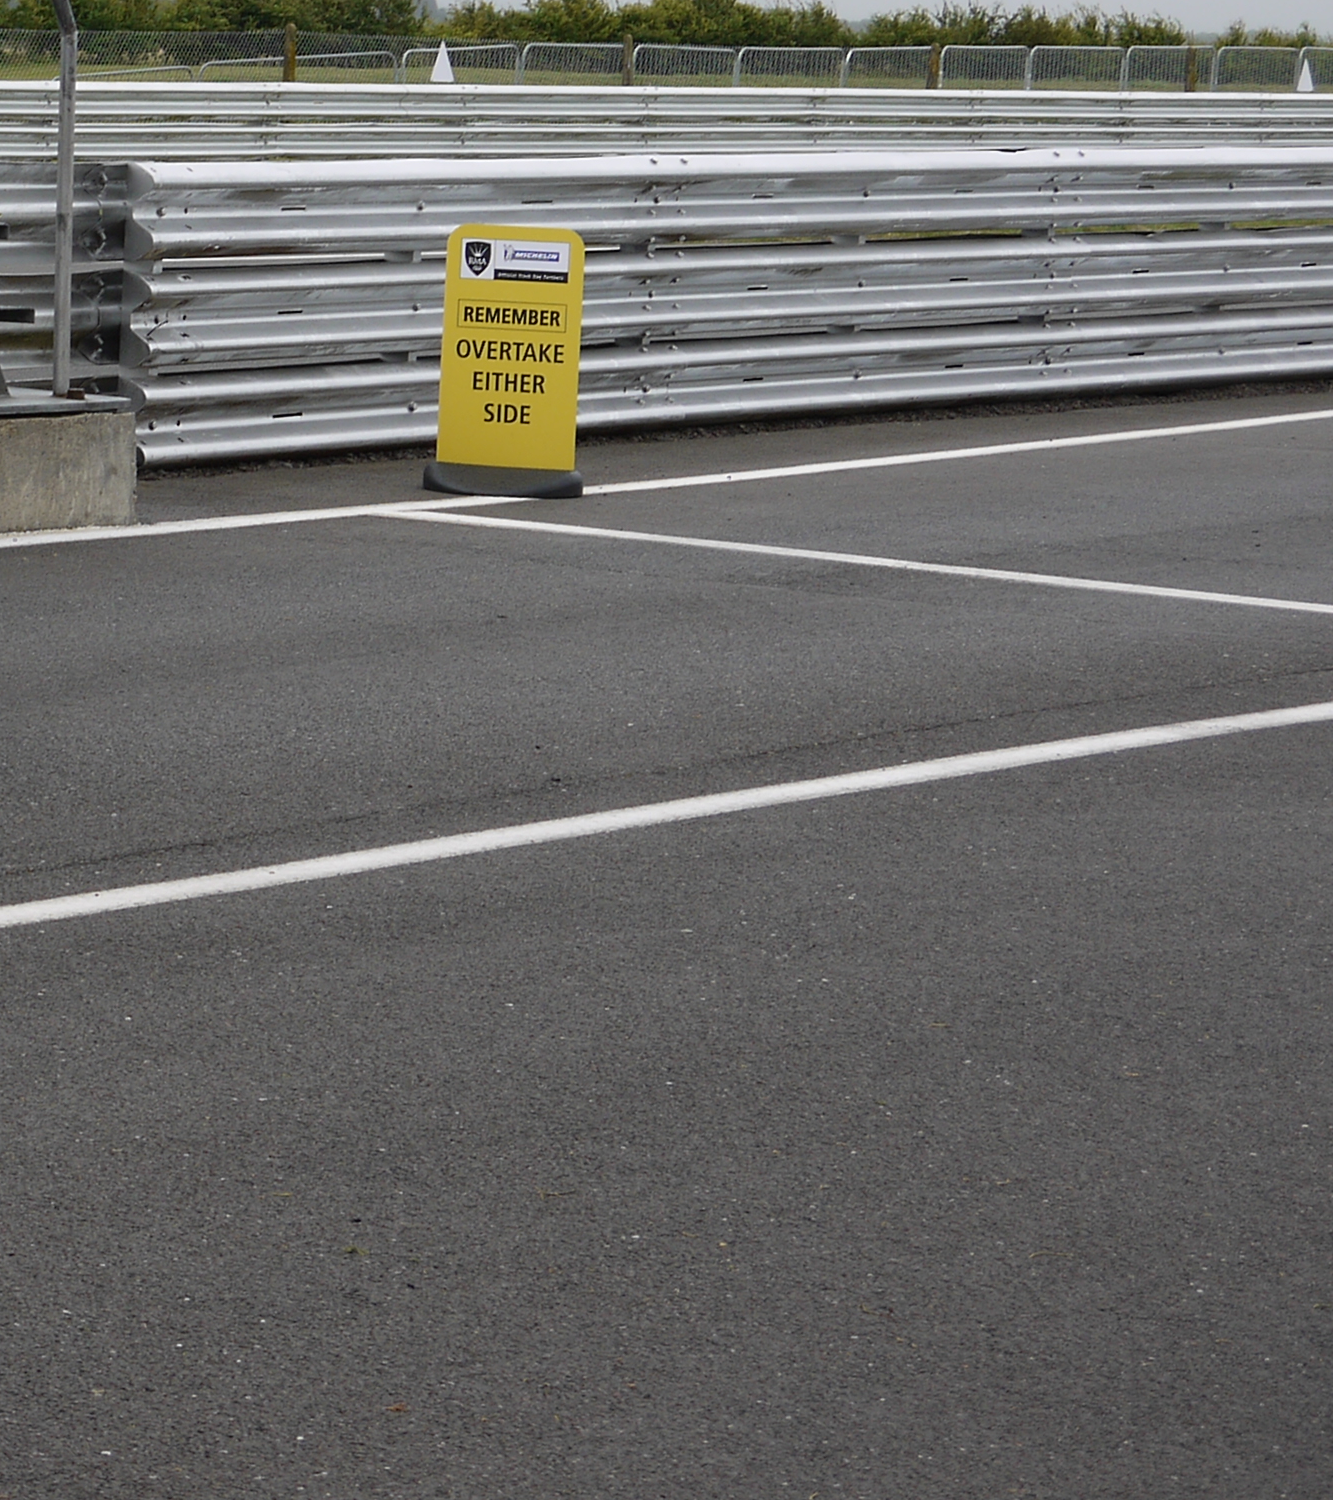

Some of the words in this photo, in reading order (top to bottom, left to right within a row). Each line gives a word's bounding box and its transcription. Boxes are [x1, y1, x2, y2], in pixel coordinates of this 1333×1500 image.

[463, 306, 561, 327] REMEMBER
[456, 338, 565, 364] OVERTAKE
[472, 371, 545, 394] EITHER
[483, 403, 531, 424] SIDE
